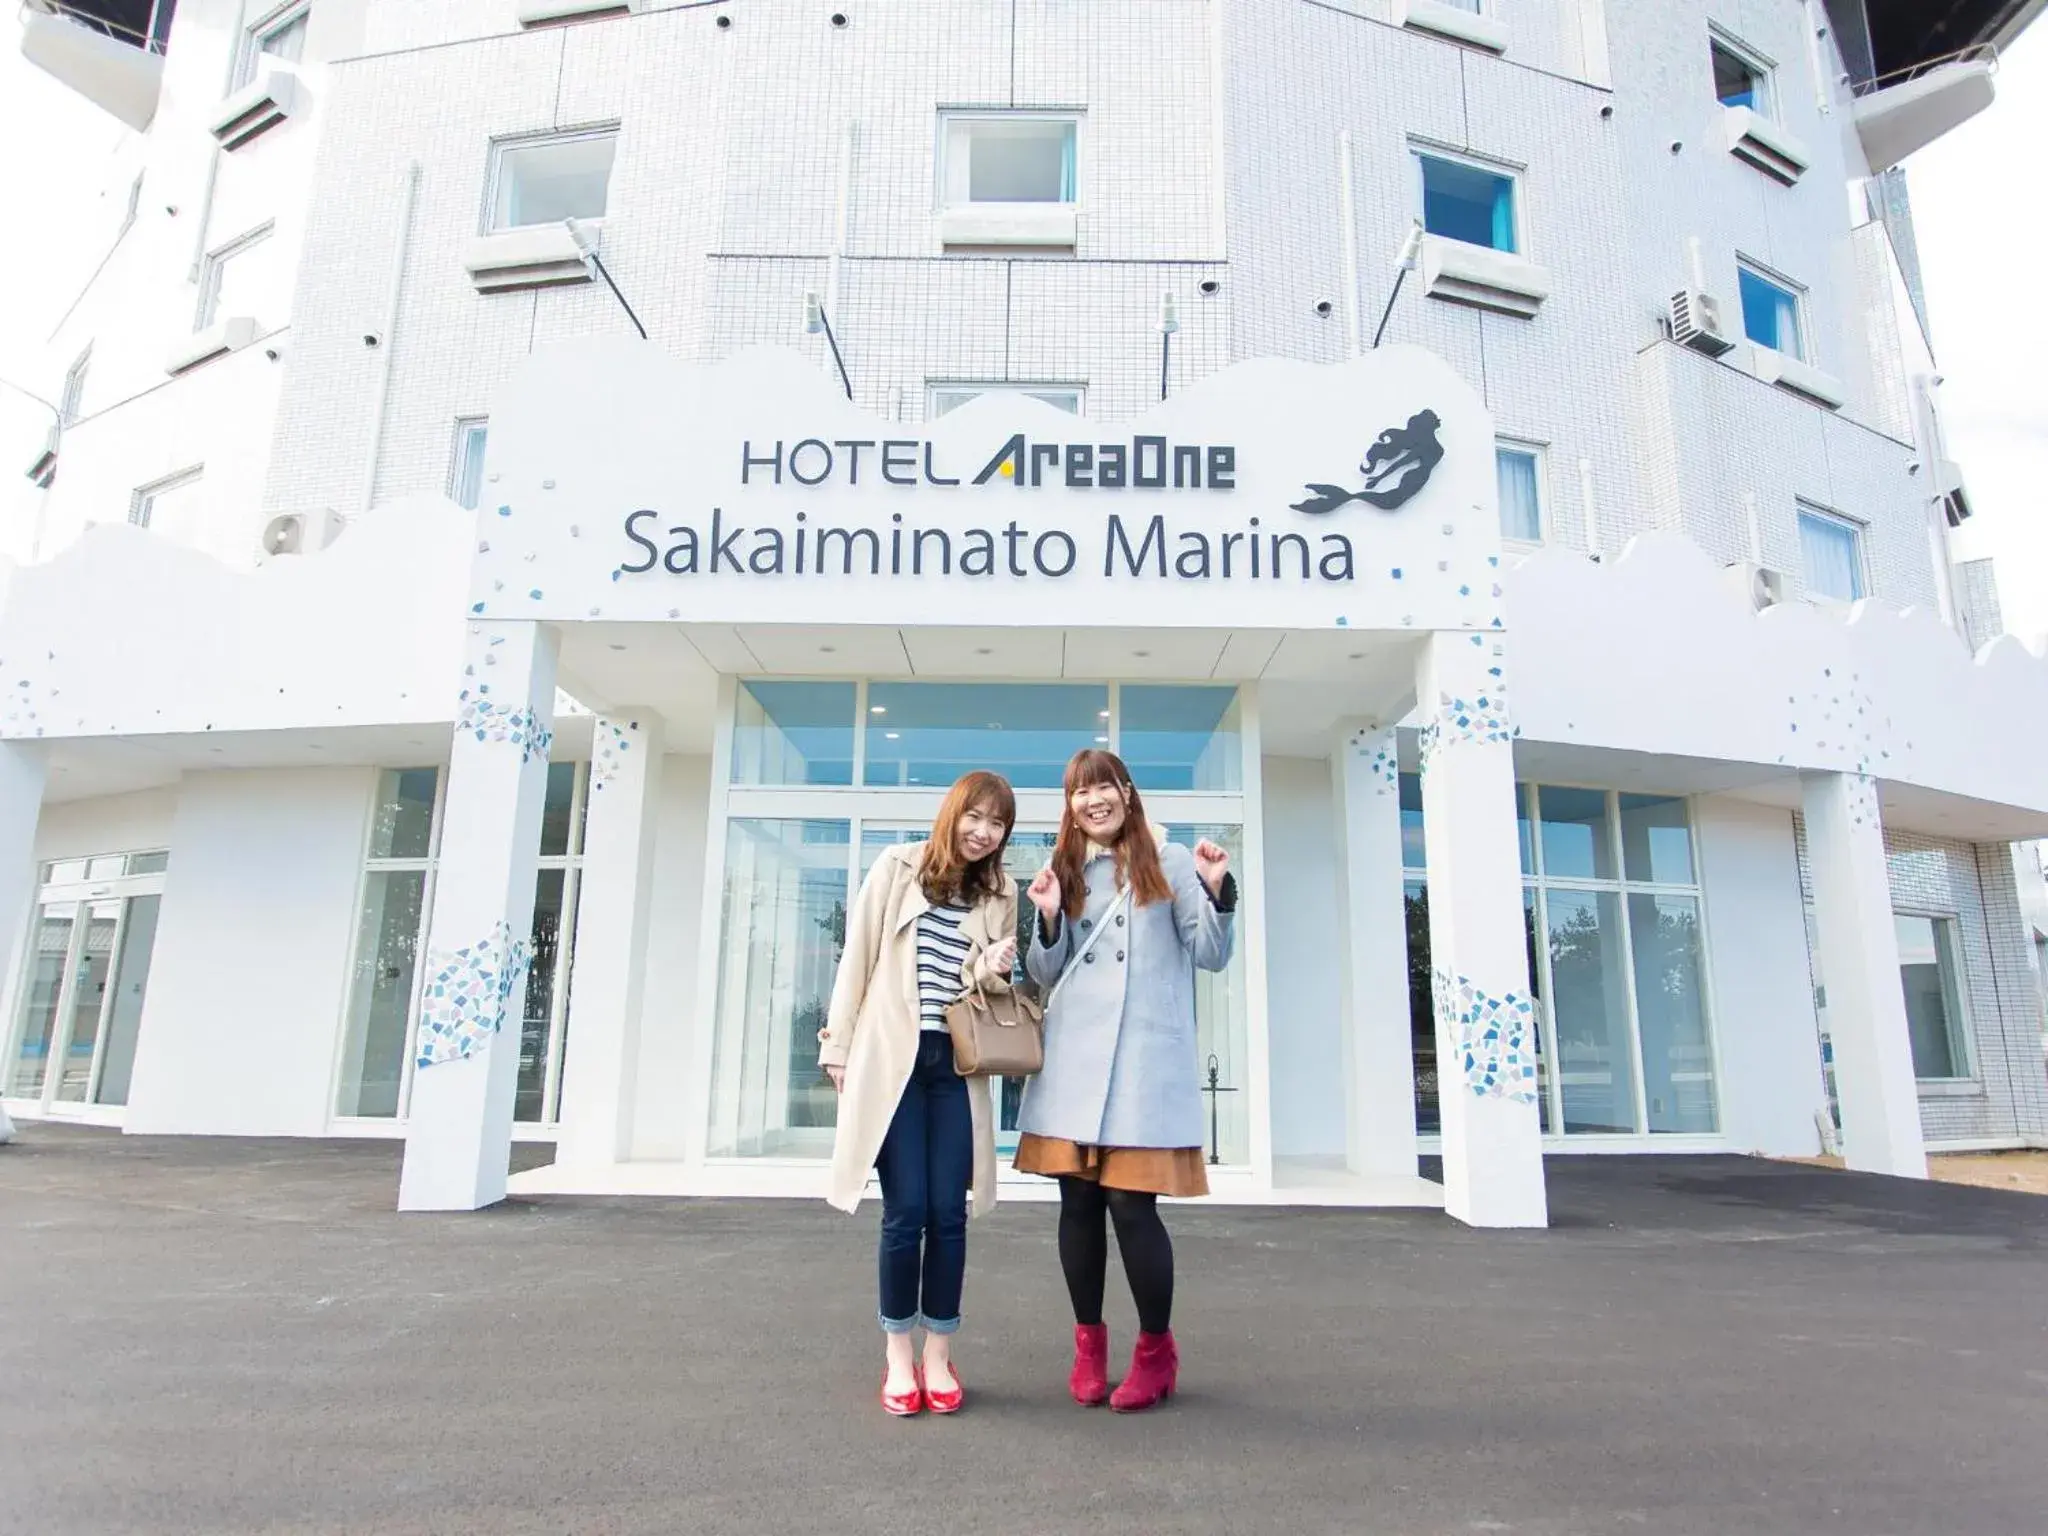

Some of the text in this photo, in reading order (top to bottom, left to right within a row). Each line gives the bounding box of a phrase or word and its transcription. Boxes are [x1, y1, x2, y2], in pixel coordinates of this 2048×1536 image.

[742, 433, 1235, 490] HOTEL AreaOne
[620, 508, 1355, 581] Sakaiminato Marina
